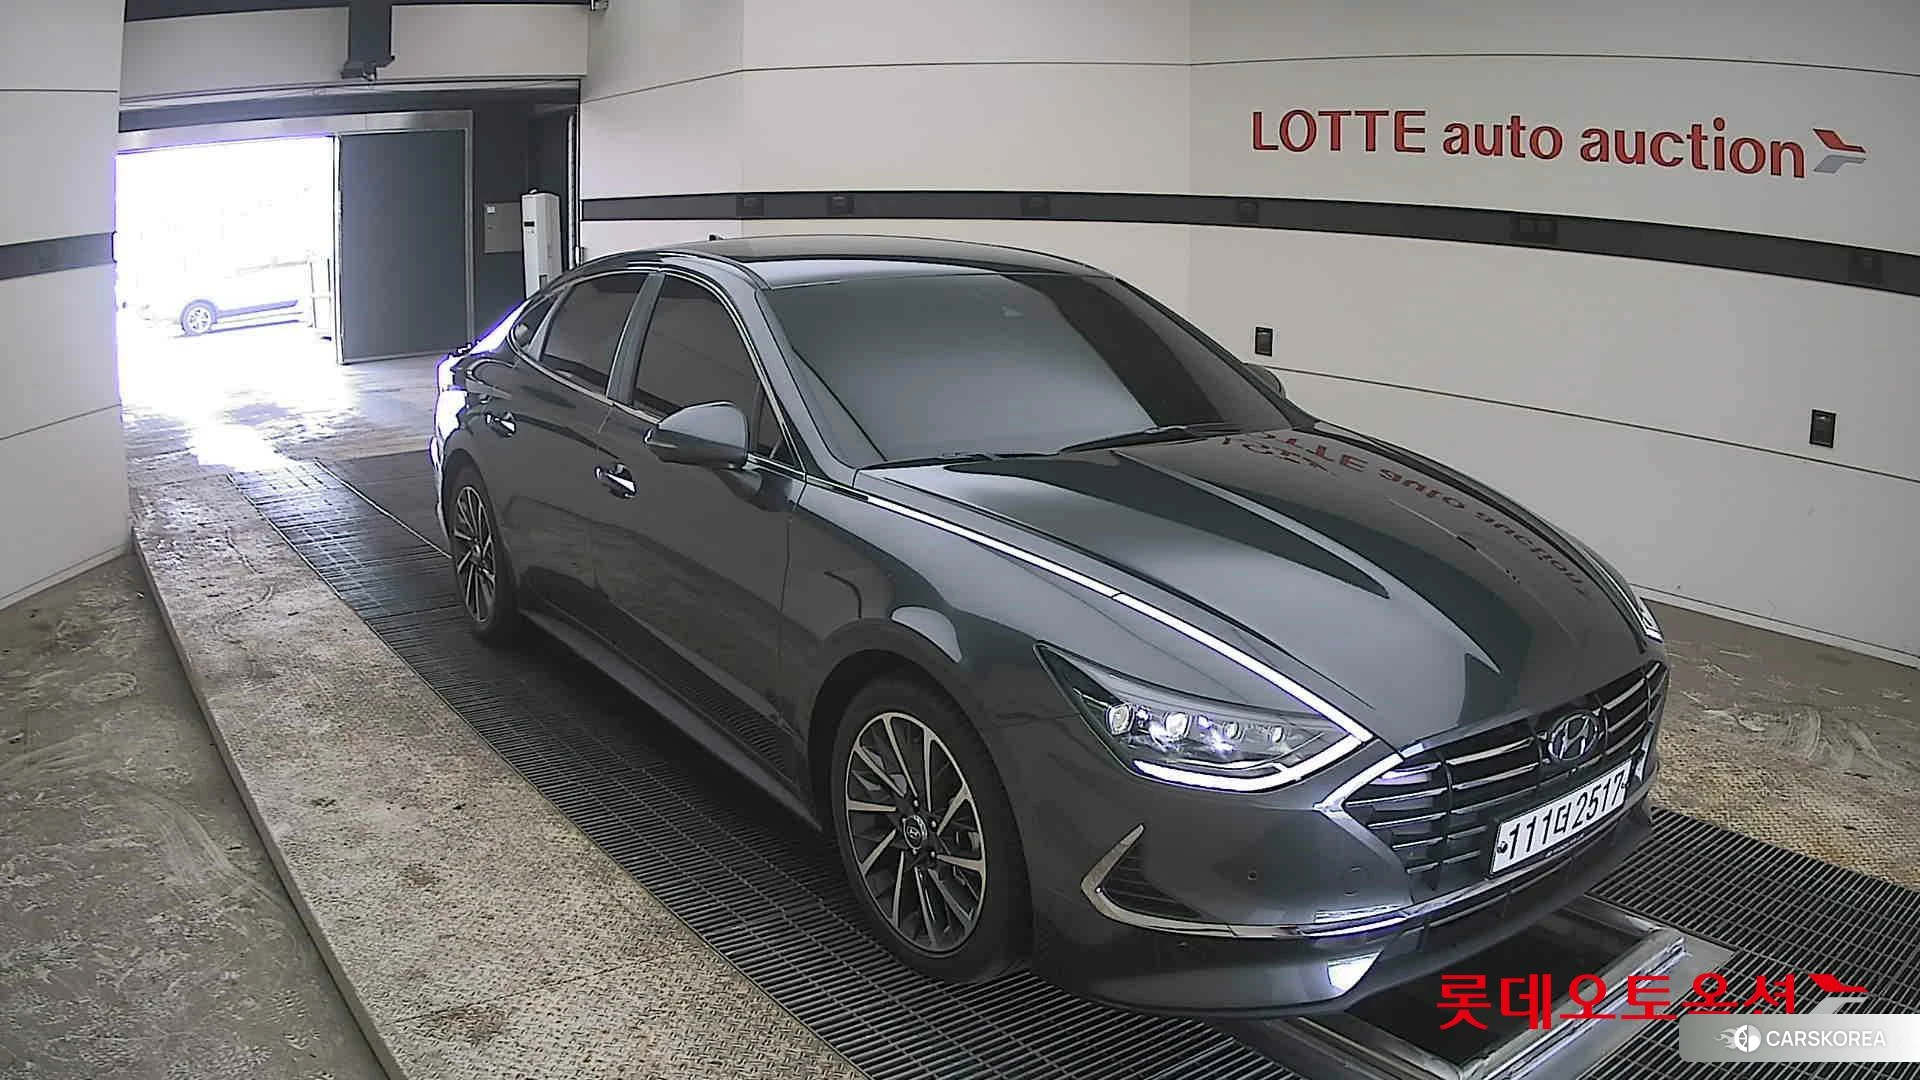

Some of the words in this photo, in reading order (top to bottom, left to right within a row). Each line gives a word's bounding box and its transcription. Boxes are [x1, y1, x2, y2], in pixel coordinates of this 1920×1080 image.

[1252, 110, 1426, 153] LOTTE
[1443, 115, 1563, 160] auto
[1580, 116, 1805, 178] auction
[1509, 769, 1625, 859] 111더2517
